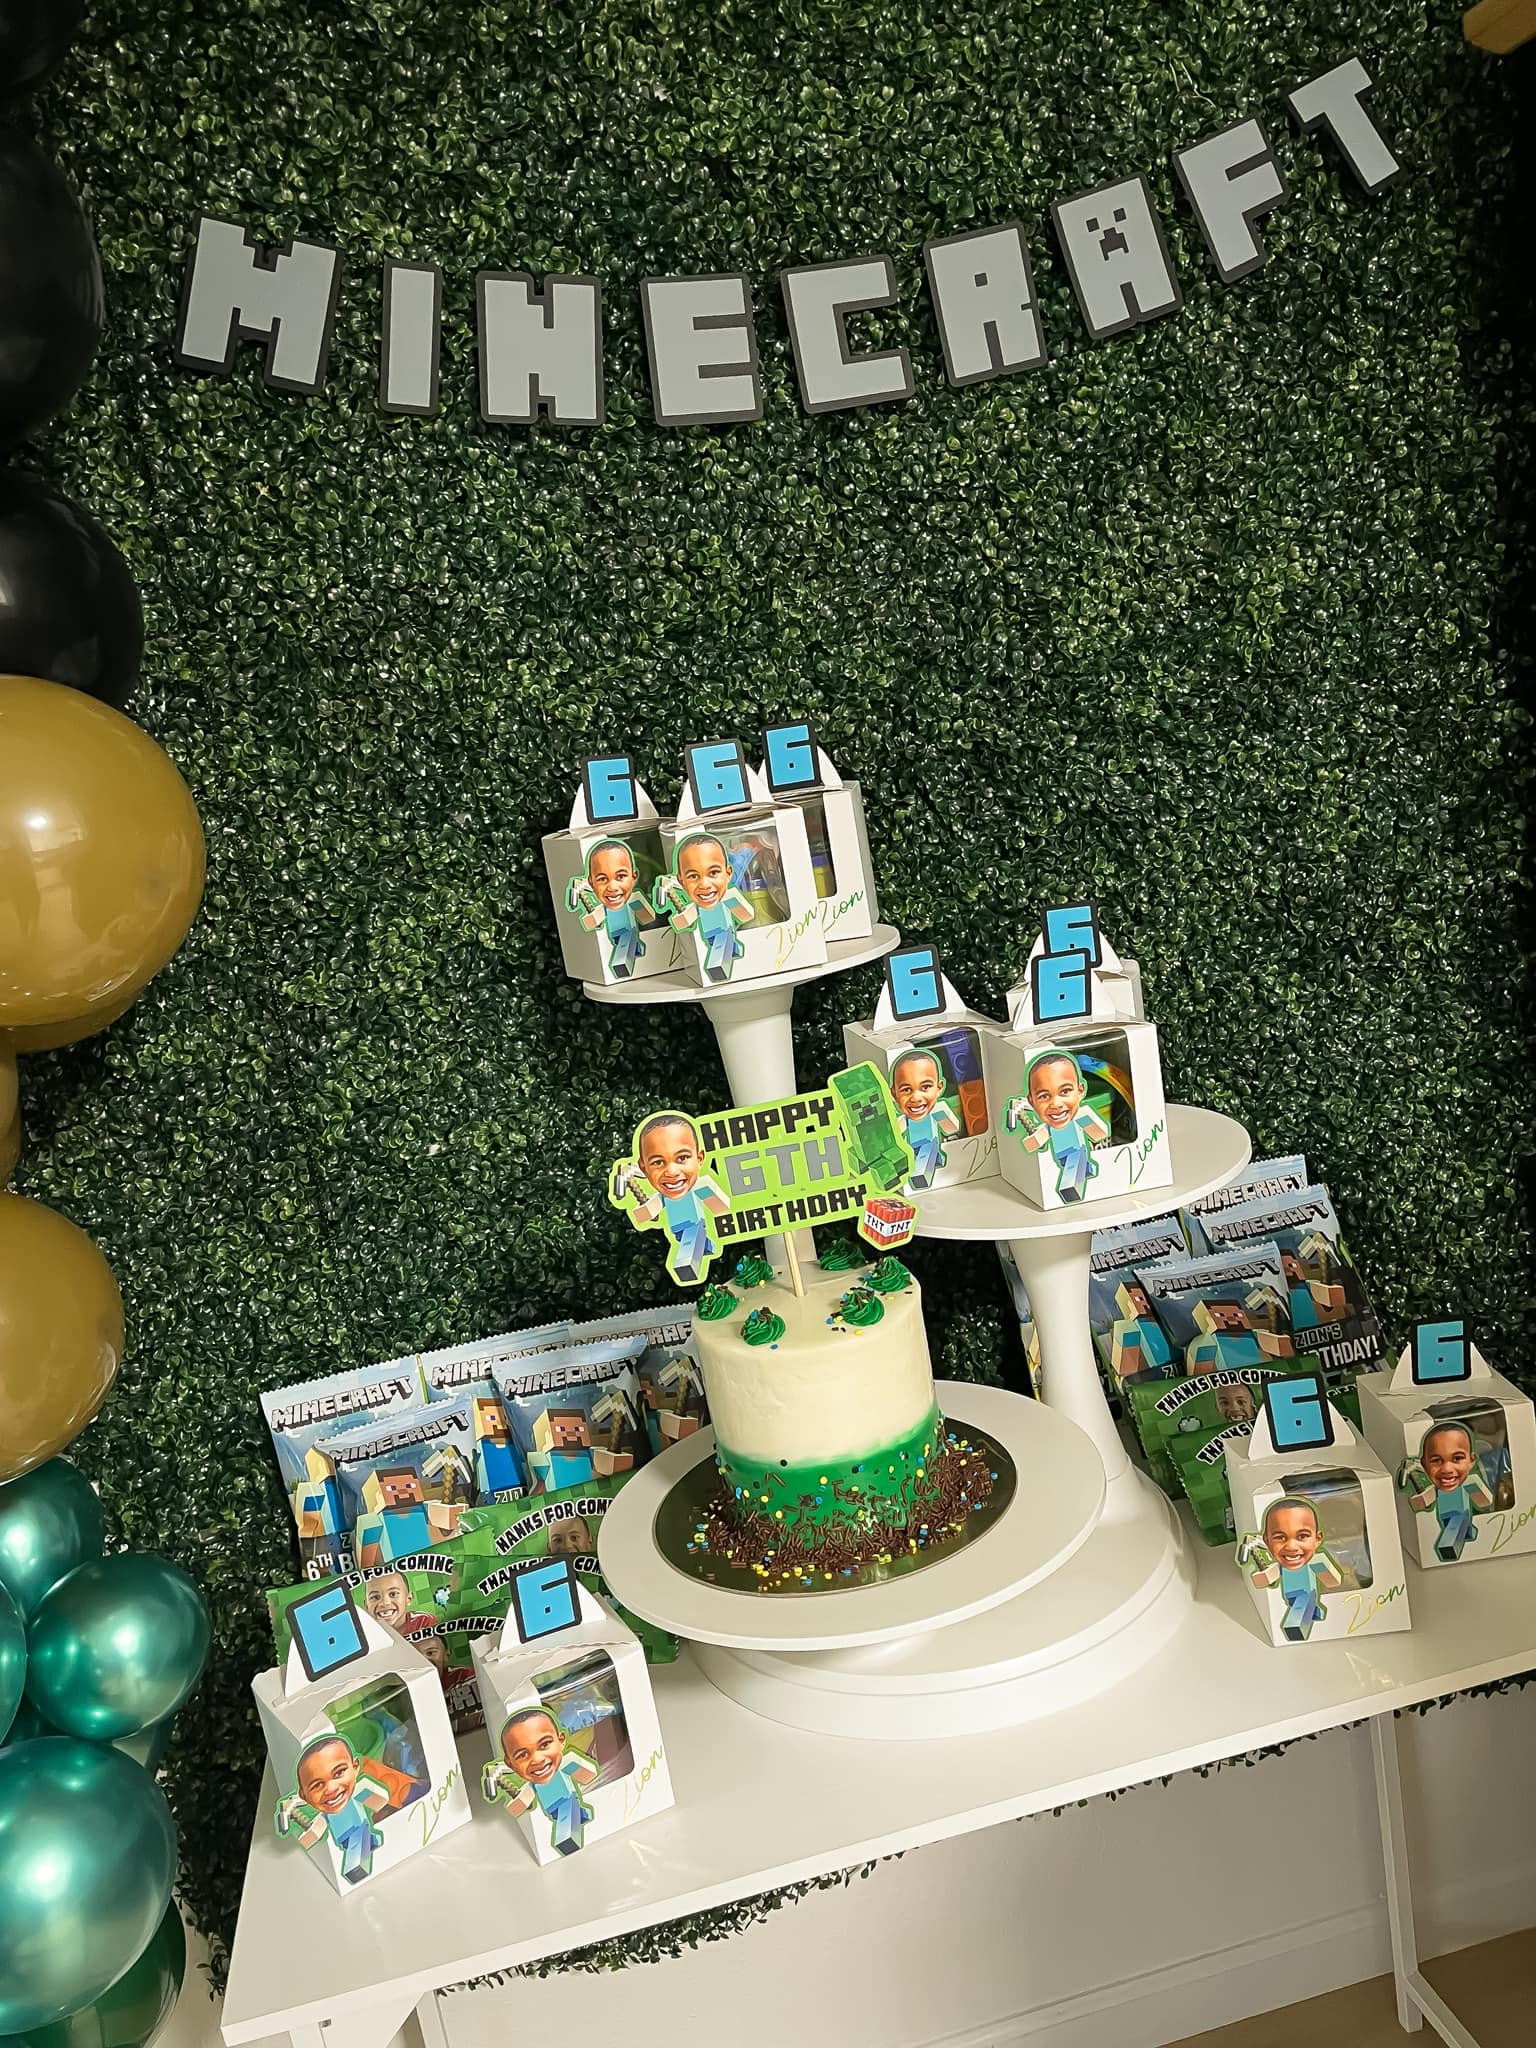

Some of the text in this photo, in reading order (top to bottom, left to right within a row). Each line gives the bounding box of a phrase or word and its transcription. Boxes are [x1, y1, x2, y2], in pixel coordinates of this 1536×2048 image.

[178, 57, 1399, 424] MINECRAFT
[690, 741, 747, 811] 6
[765, 723, 816, 788] 6
[586, 757, 638, 820] 6
[766, 906, 818, 969] Zion
[888, 948, 941, 1016] 6
[1037, 952, 1087, 1020] 6
[700, 1096, 833, 1151] HAPPY
[724, 1135, 844, 1196] 6TH
[962, 1135, 998, 1179] Zio
[1113, 1118, 1165, 1189] Zion
[714, 1184, 867, 1238] BIRTHDAY
[1188, 1171, 1308, 1216] MINECRAFT
[1211, 1199, 1330, 1245] MINECRAFT
[867, 1214, 911, 1234] TNT TNT
[1152, 1257, 1281, 1298] MINECRAFT
[1294, 1323, 1343, 1349] ZION'S
[1416, 1319, 1465, 1381] 6
[271, 1375, 414, 1432] MINECRAFT
[503, 1354, 640, 1399] MINECRAFT
[1156, 1378, 1210, 1415] THANKS
[1209, 1371, 1239, 1388] FOR
[329, 1409, 470, 1467] MINECRAFT
[1266, 1377, 1327, 1447] 6
[496, 1511, 544, 1554] HANKS
[544, 1501, 574, 1524] FOR
[306, 1552, 334, 1581] 6TH
[436, 1619, 505, 1634] COMING!
[515, 1559, 576, 1640] 6
[1343, 1583, 1405, 1635] Zion
[293, 1585, 361, 1675] 6
[407, 1763, 459, 1846] Zion
